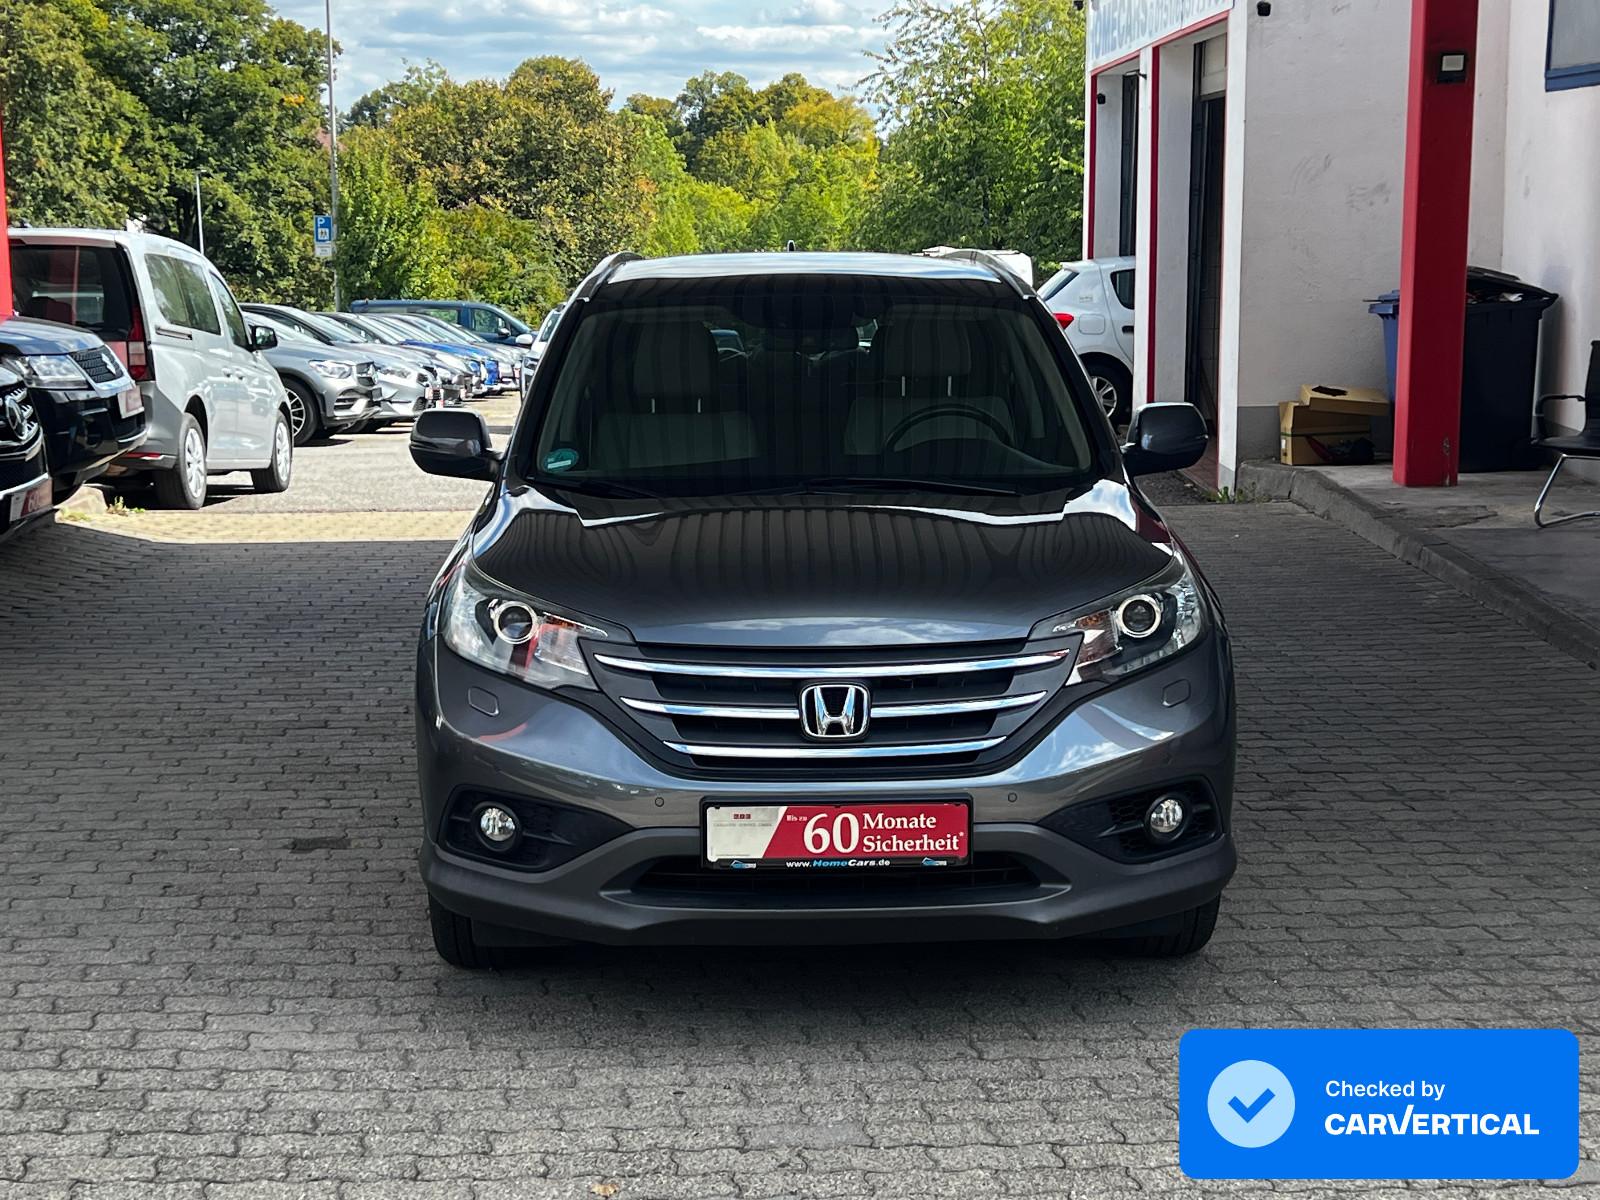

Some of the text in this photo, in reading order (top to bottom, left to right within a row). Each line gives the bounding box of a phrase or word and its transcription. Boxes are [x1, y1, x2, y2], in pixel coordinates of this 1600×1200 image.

[317, 217, 326, 228] P
[803, 813, 860, 854] 60
[862, 812, 937, 830] Monate
